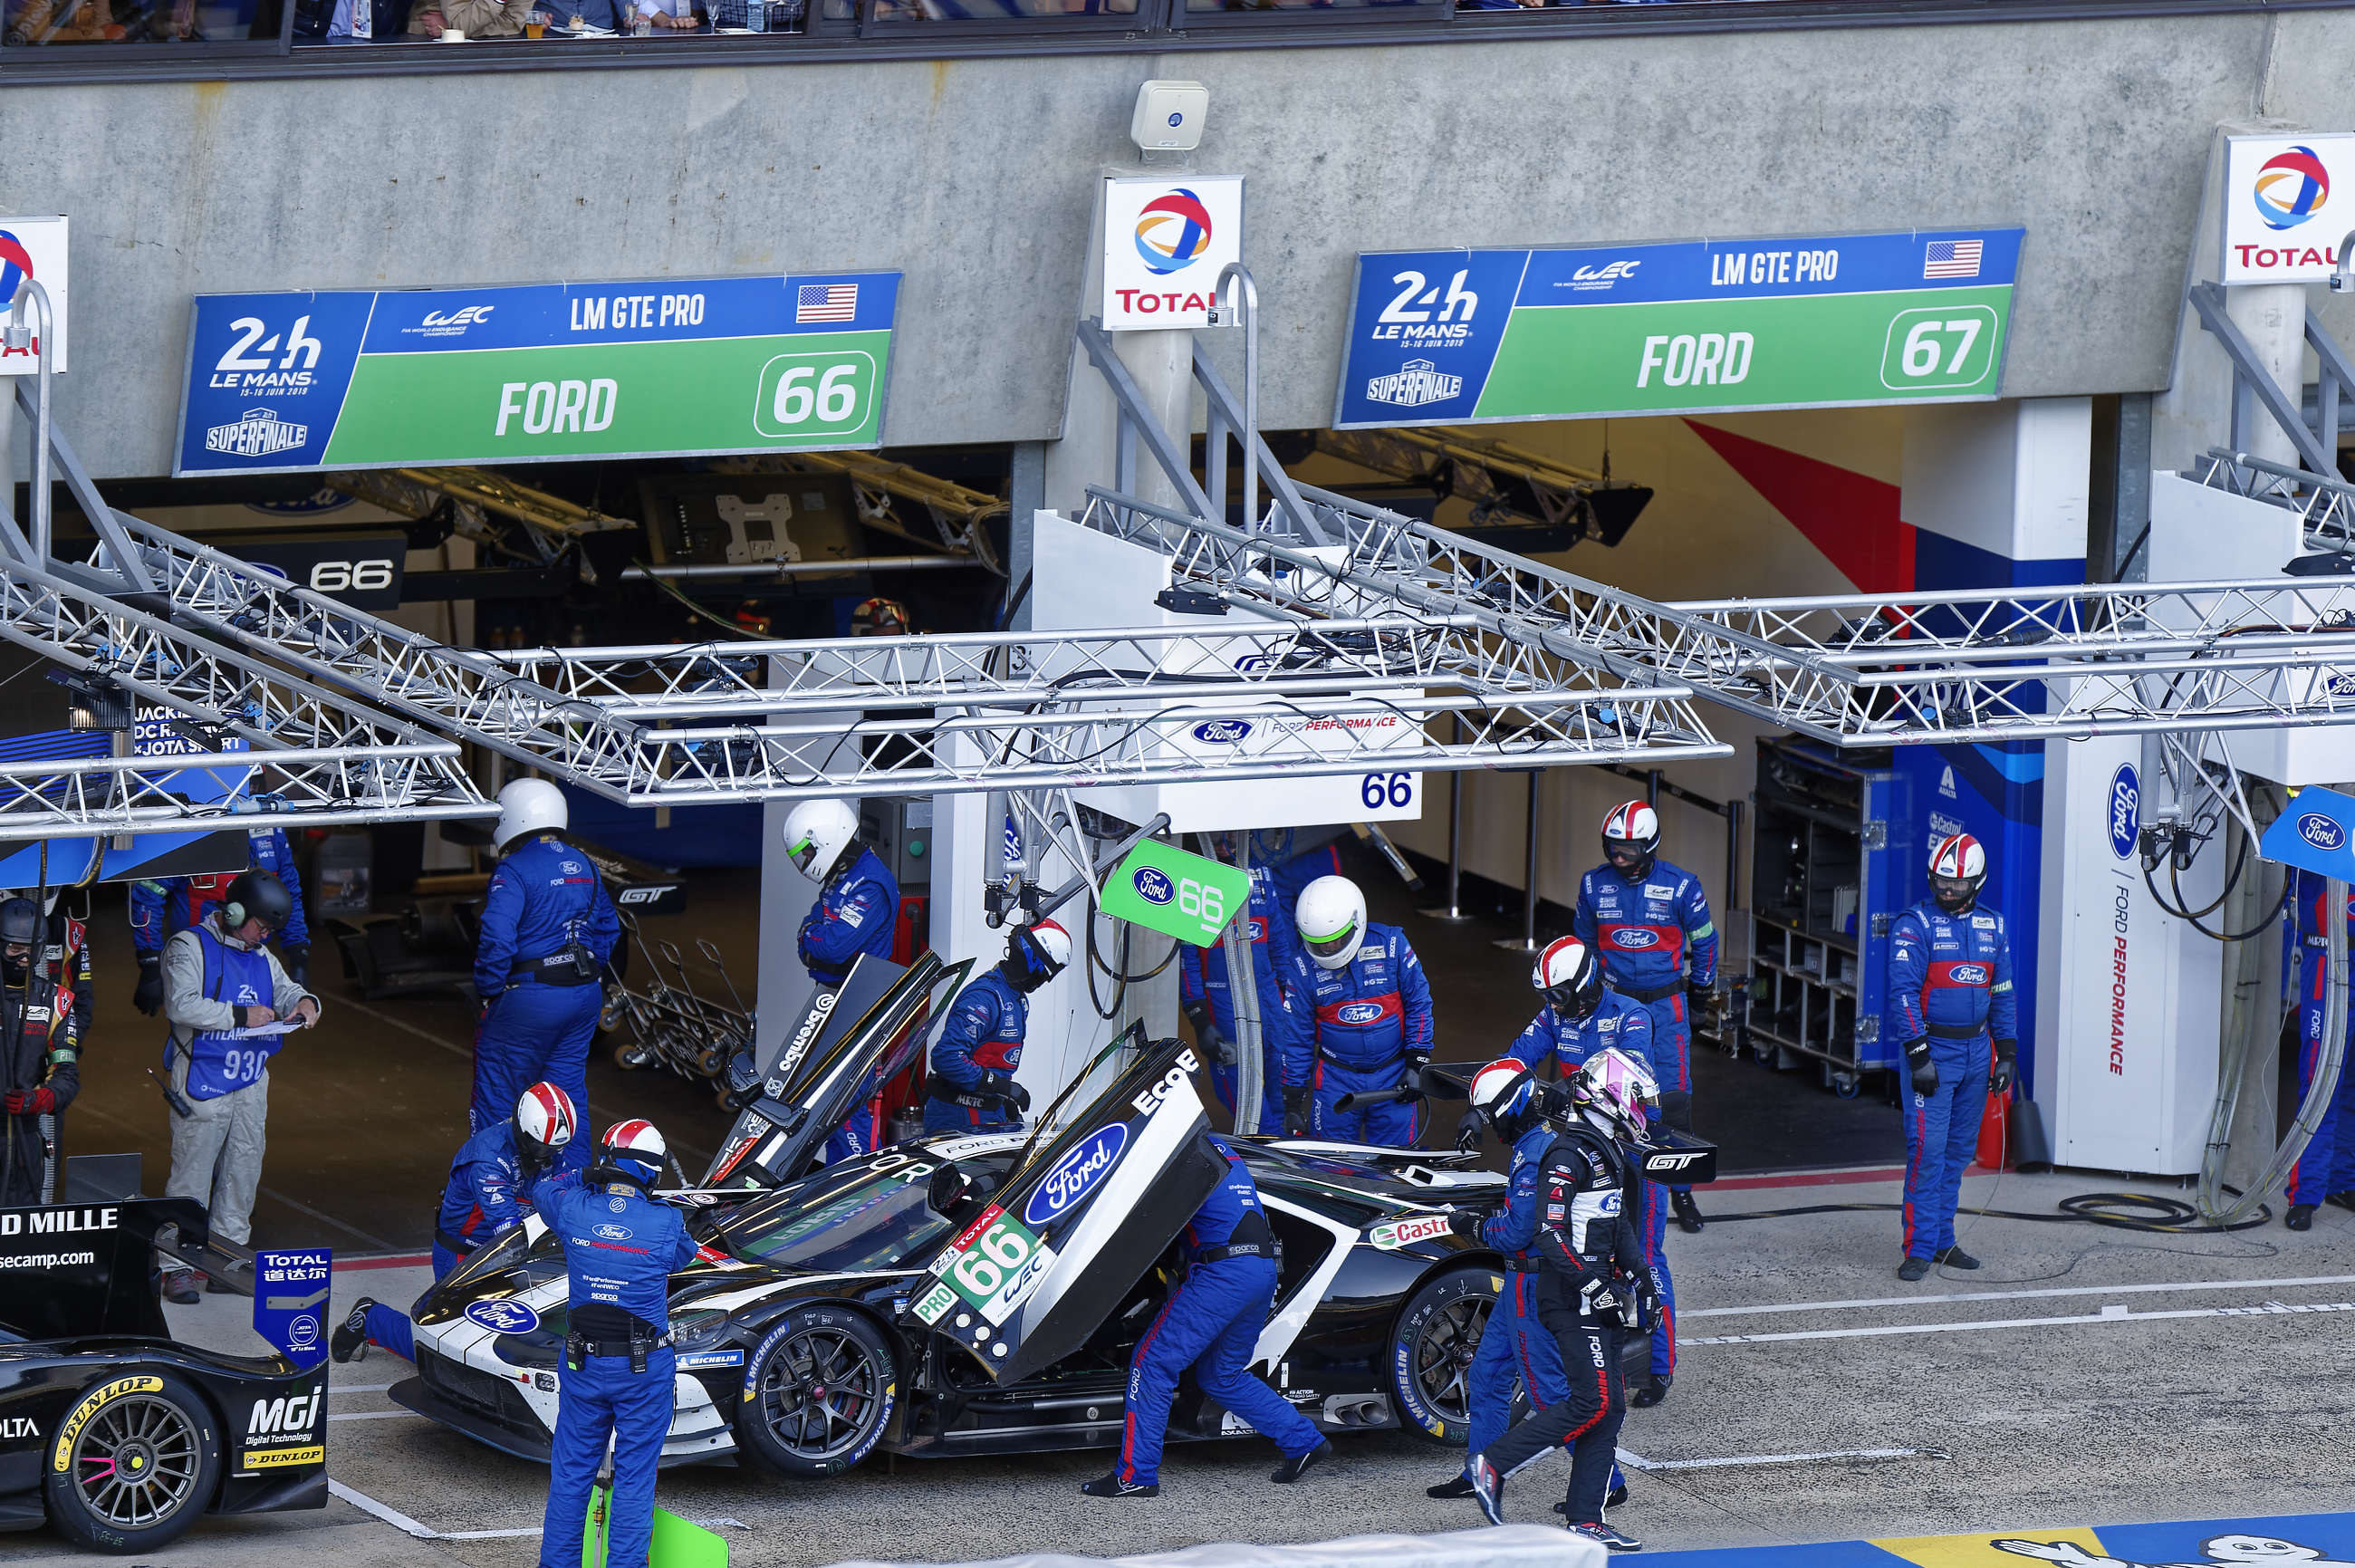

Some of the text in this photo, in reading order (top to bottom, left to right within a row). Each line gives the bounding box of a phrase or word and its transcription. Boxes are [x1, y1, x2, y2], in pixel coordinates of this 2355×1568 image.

[1572, 260, 1641, 281] WEC
[1711, 249, 1839, 285] LM GTE PRO
[2235, 245, 2338, 268] TOTAL
[1378, 268, 1479, 323] 24h
[422, 305, 495, 326] WEC
[571, 293, 705, 331] LM GTE PRO
[215, 314, 322, 370] 24h
[1372, 323, 1469, 340] LE MANS
[1400, 340, 1423, 348] 15-16
[1445, 339, 1465, 347] 2019
[1637, 332, 1754, 388] FORD
[1901, 318, 1982, 378] 67
[209, 371, 312, 388] LE MANS
[240, 387, 308, 397] 15-16 JUIN 2019
[773, 364, 858, 424] 66
[1369, 370, 1460, 405] SUPERFINALE
[495, 378, 618, 437] FORD
[208, 420, 305, 455] SUPERFINALE
[310, 559, 394, 592] 66
[1361, 772, 1412, 809] 66
[1937, 816, 1962, 835] Castrol
[2113, 782, 2139, 840] Ford
[2306, 817, 2337, 845] Ford
[619, 886, 678, 904] GT
[1178, 877, 1224, 924] 66
[1619, 930, 1650, 946] Ford
[1957, 967, 1985, 982] Ford
[2110, 884, 2130, 1076] FORD PERFORMANCE
[1345, 1006, 1374, 1022] Ford
[779, 1009, 827, 1072] brembo
[224, 1050, 269, 1082] 930
[946, 1138, 1004, 1154] FORD
[1647, 1152, 1709, 1171] GT
[1044, 1138, 1110, 1210] Ford
[29, 1207, 119, 1234] MILLE
[599, 1225, 625, 1238] Ford
[956, 1209, 998, 1246] TOTAL
[1396, 1217, 1449, 1242] Castr
[264, 1255, 328, 1266] TOTAL
[572, 1237, 649, 1255] FORD PERFORMANCE
[953, 1223, 1029, 1296] 66
[264, 1267, 327, 1282] 道达尔
[1004, 1255, 1043, 1303] WEC
[1651, 1266, 1665, 1295] FORD
[918, 1287, 953, 1321] PRO
[689, 1353, 738, 1365] MICHELIN
[749, 1324, 787, 1383] MICHELIN
[1588, 1335, 1604, 1368] FORD
[1129, 1367, 1141, 1402] FORD
[1398, 1349, 1426, 1420] MICHELIN
[62, 1376, 154, 1442] DUNLOP
[0, 1418, 40, 1438] LTA
[245, 1432, 312, 1447] Digital Technology
[854, 1401, 892, 1460] MICHELIN
[258, 1449, 322, 1464] DUNLOP
